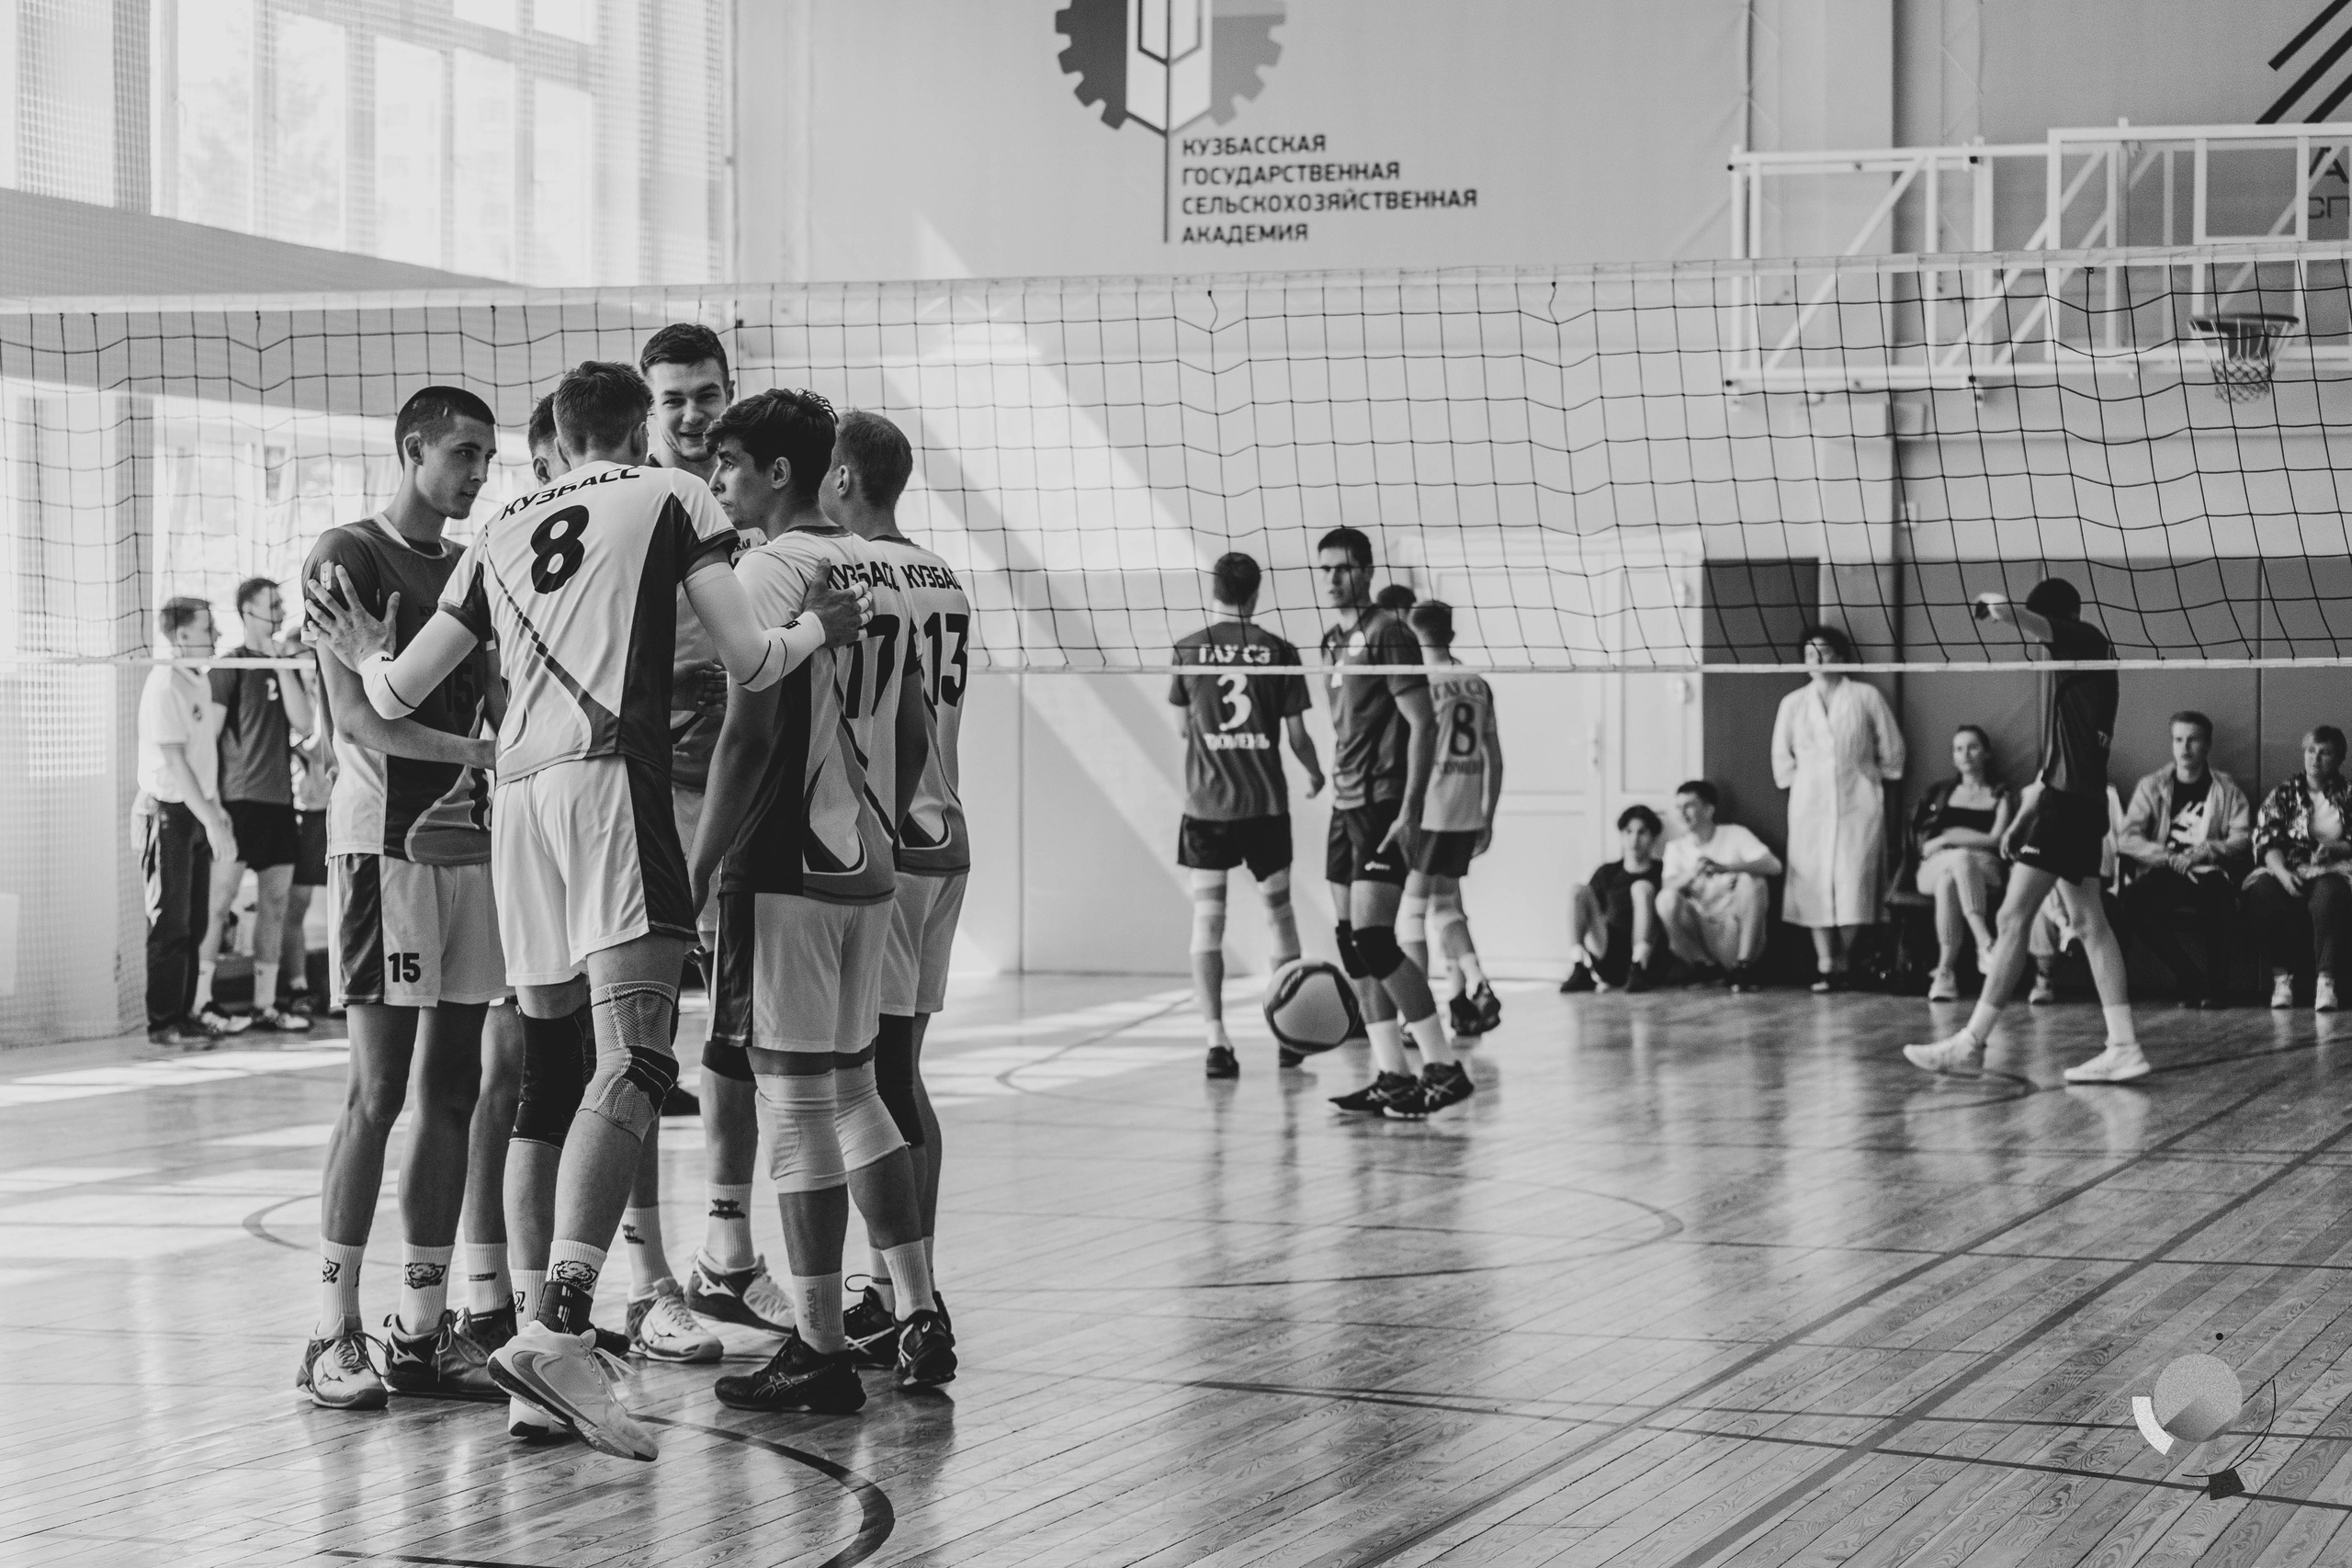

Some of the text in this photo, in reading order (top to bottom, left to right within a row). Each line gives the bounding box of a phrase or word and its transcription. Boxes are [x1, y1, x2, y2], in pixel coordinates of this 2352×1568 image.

[1182, 134, 1327, 157] КУЗБАССКАЯ
[1182, 162, 1401, 186] ГОСУДАРСТВЕННАЯ
[1182, 189, 1478, 216] СЕЛЬСКОХОЗЯЙСТВЕННАЯ
[1182, 223, 1309, 246] АКАДЕМИЯ
[500, 466, 641, 522] КУЗБАСС
[530, 504, 590, 595] 8
[845, 614, 900, 719] 17
[923, 612, 969, 707] 13
[1217, 672, 1252, 731] 3
[1450, 703, 1476, 757] 8
[388, 953, 422, 983] 15
[803, 1287, 821, 1332] MIKASA
